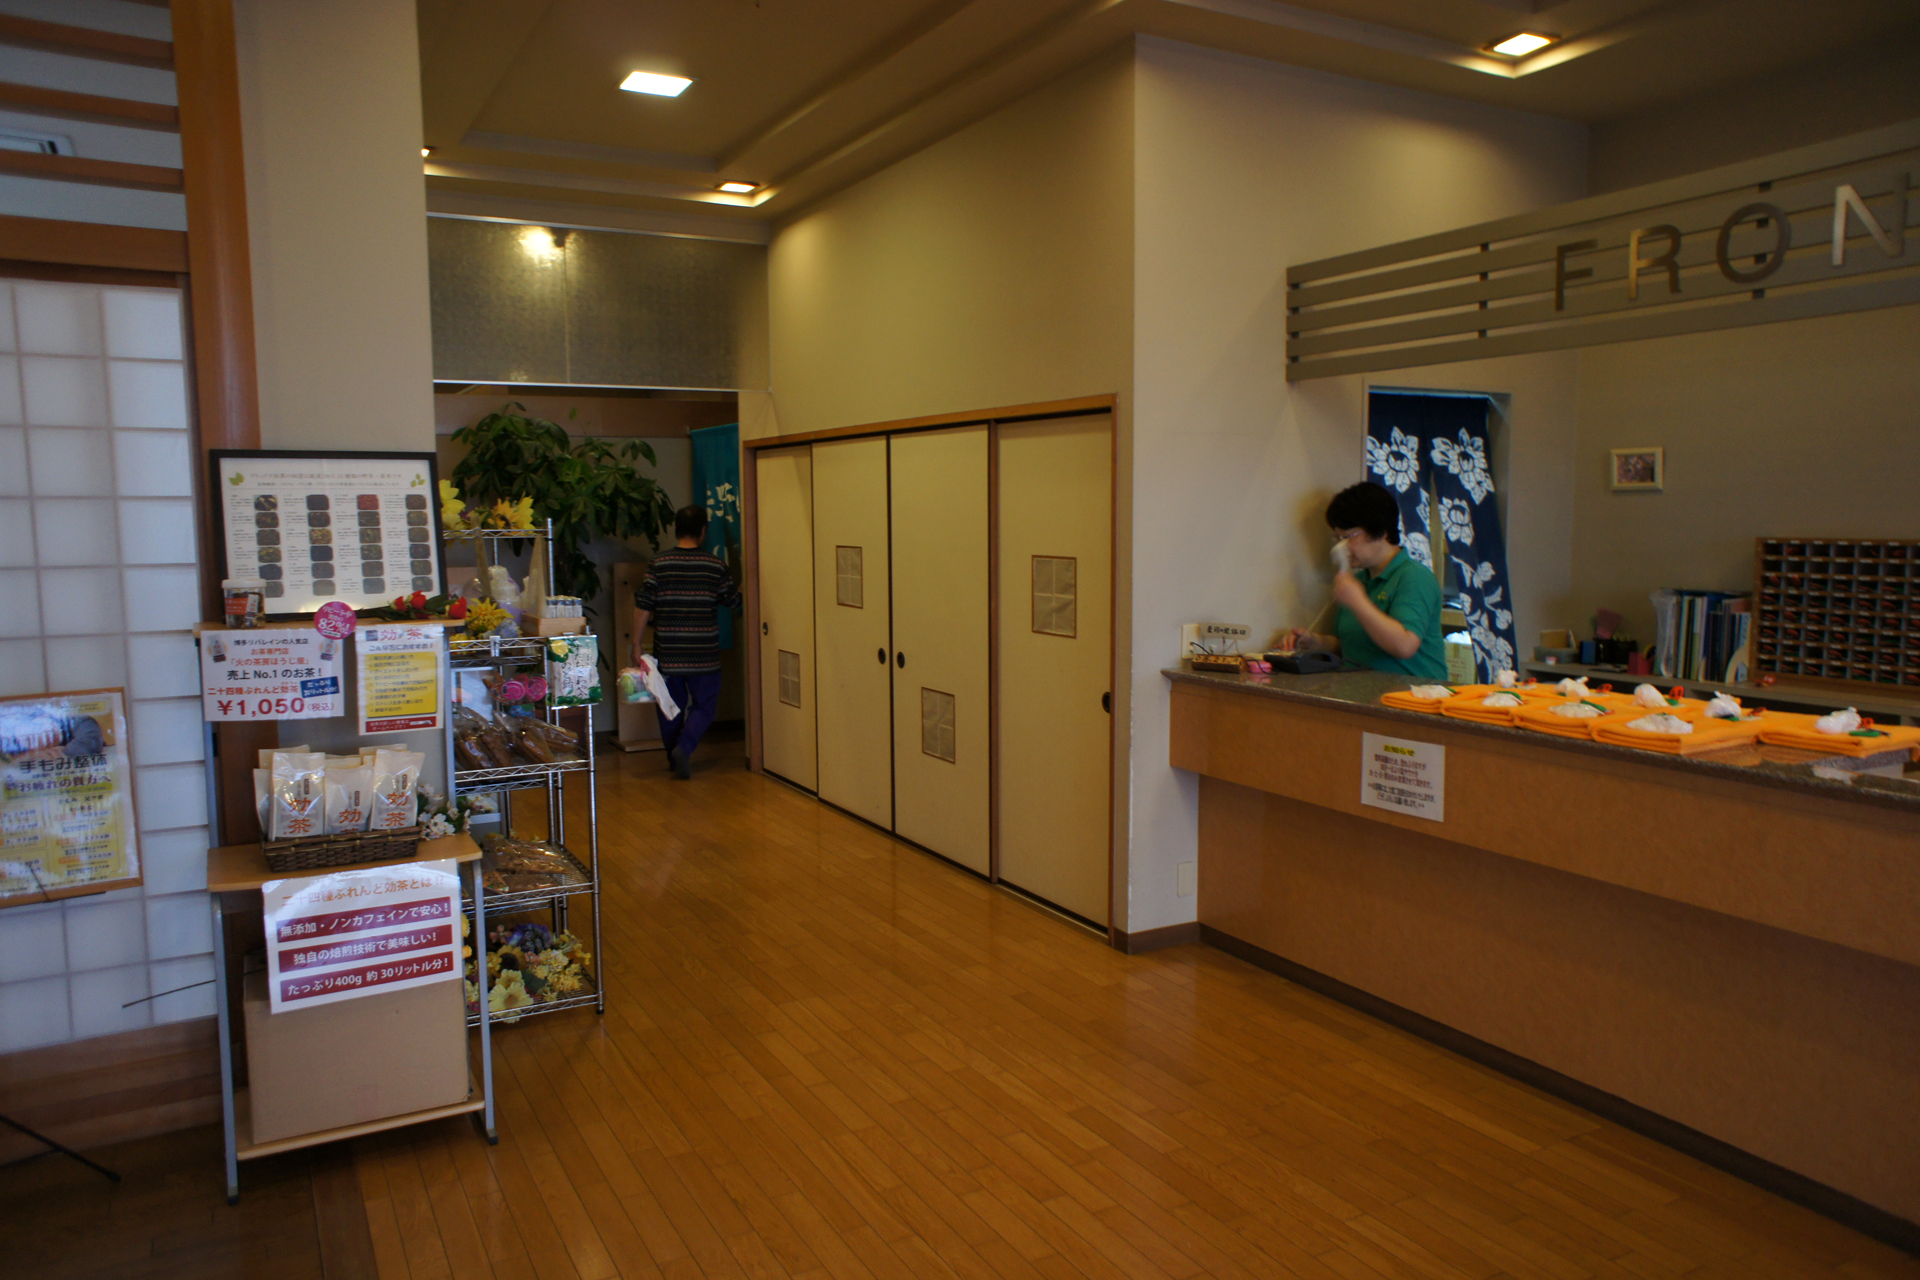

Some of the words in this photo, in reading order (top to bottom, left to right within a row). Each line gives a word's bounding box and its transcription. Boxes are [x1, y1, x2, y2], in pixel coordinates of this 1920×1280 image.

[1553, 172, 1910, 312] FRON
[233, 638, 309, 646] 博多リバレインの人気店
[227, 670, 251, 681] 売上
[254, 669, 278, 679] No.1
[208, 685, 299, 695] 二十四種ぶれんど効茶
[217, 697, 305, 718] ¥1,050
[19, 753, 108, 774] 手もみ整体
[280, 903, 449, 937] 無添加・ノンカフェインで安心！
[293, 932, 437, 966] 独自の焙煎技術で美味しい！
[287, 975, 363, 997] たっぷり400g
